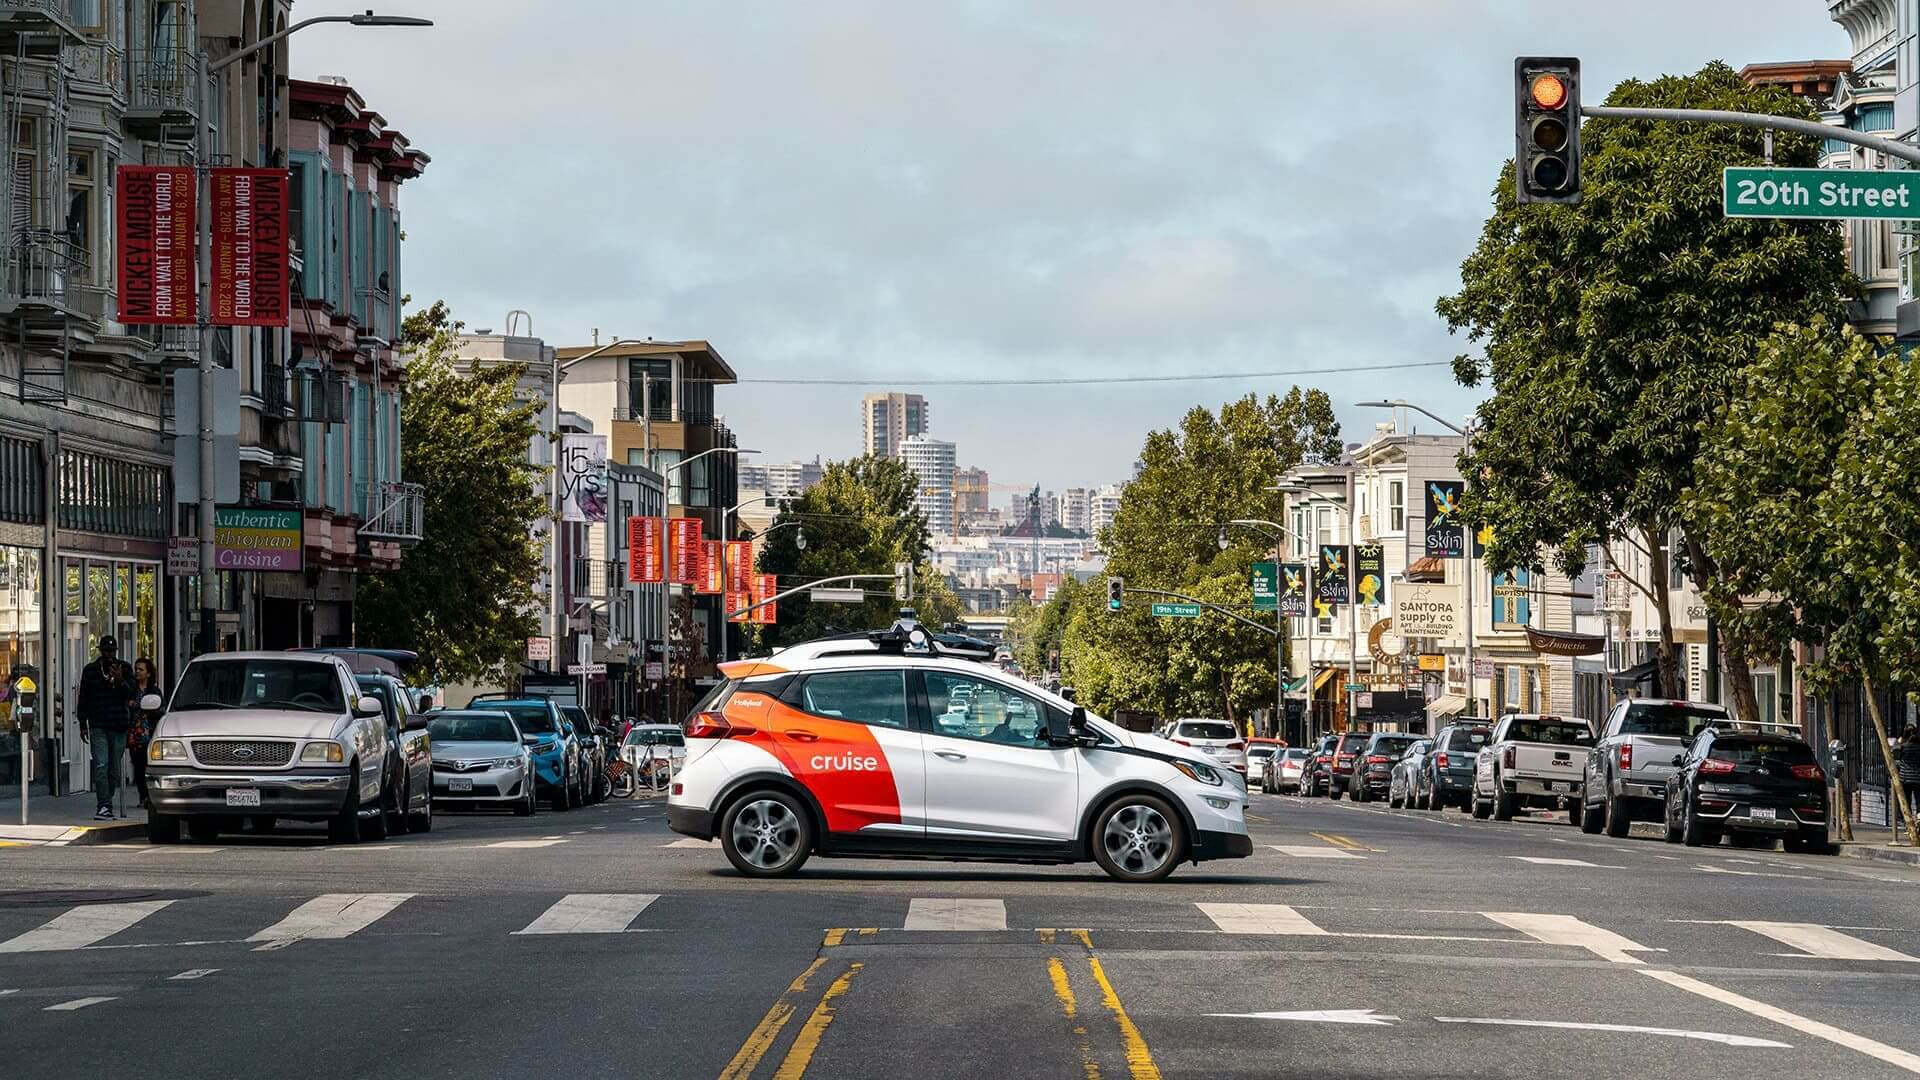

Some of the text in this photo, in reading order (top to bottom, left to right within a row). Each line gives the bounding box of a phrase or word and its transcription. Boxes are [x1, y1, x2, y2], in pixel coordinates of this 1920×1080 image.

[175, 173, 188, 198] 2020
[219, 175, 231, 194] MAY
[1737, 179, 1910, 208] 20th Street
[175, 199, 188, 209] 6,
[175, 210, 187, 249] JANUARY
[220, 211, 231, 232] 2019
[126, 172, 152, 316] MICKEY MOUSE
[156, 172, 172, 317] FROM WALT TO THE WORLD
[235, 175, 250, 318] FROM WALT TO THE WORLD
[255, 176, 281, 318] MICKEY MOUSE
[175, 258, 187, 281] 2019
[220, 242, 231, 280] JANUARY
[175, 298, 188, 317] MAY
[219, 294, 231, 318] 2020
[561, 447, 588, 474] 15
[560, 474, 600, 500] yrs
[214, 511, 290, 528] Authentic
[214, 530, 292, 549] thiopian
[632, 520, 645, 580] MICKEY MOUSE
[220, 549, 281, 567] Cuisine
[686, 522, 698, 581] MICKEY MOUSE
[1400, 602, 1453, 612] SANTORA
[1400, 612, 1455, 623] supply co.
[1535, 637, 1587, 650] Amnesia
[569, 665, 605, 673] CUNNNGHAM
[811, 751, 878, 771] cruise
